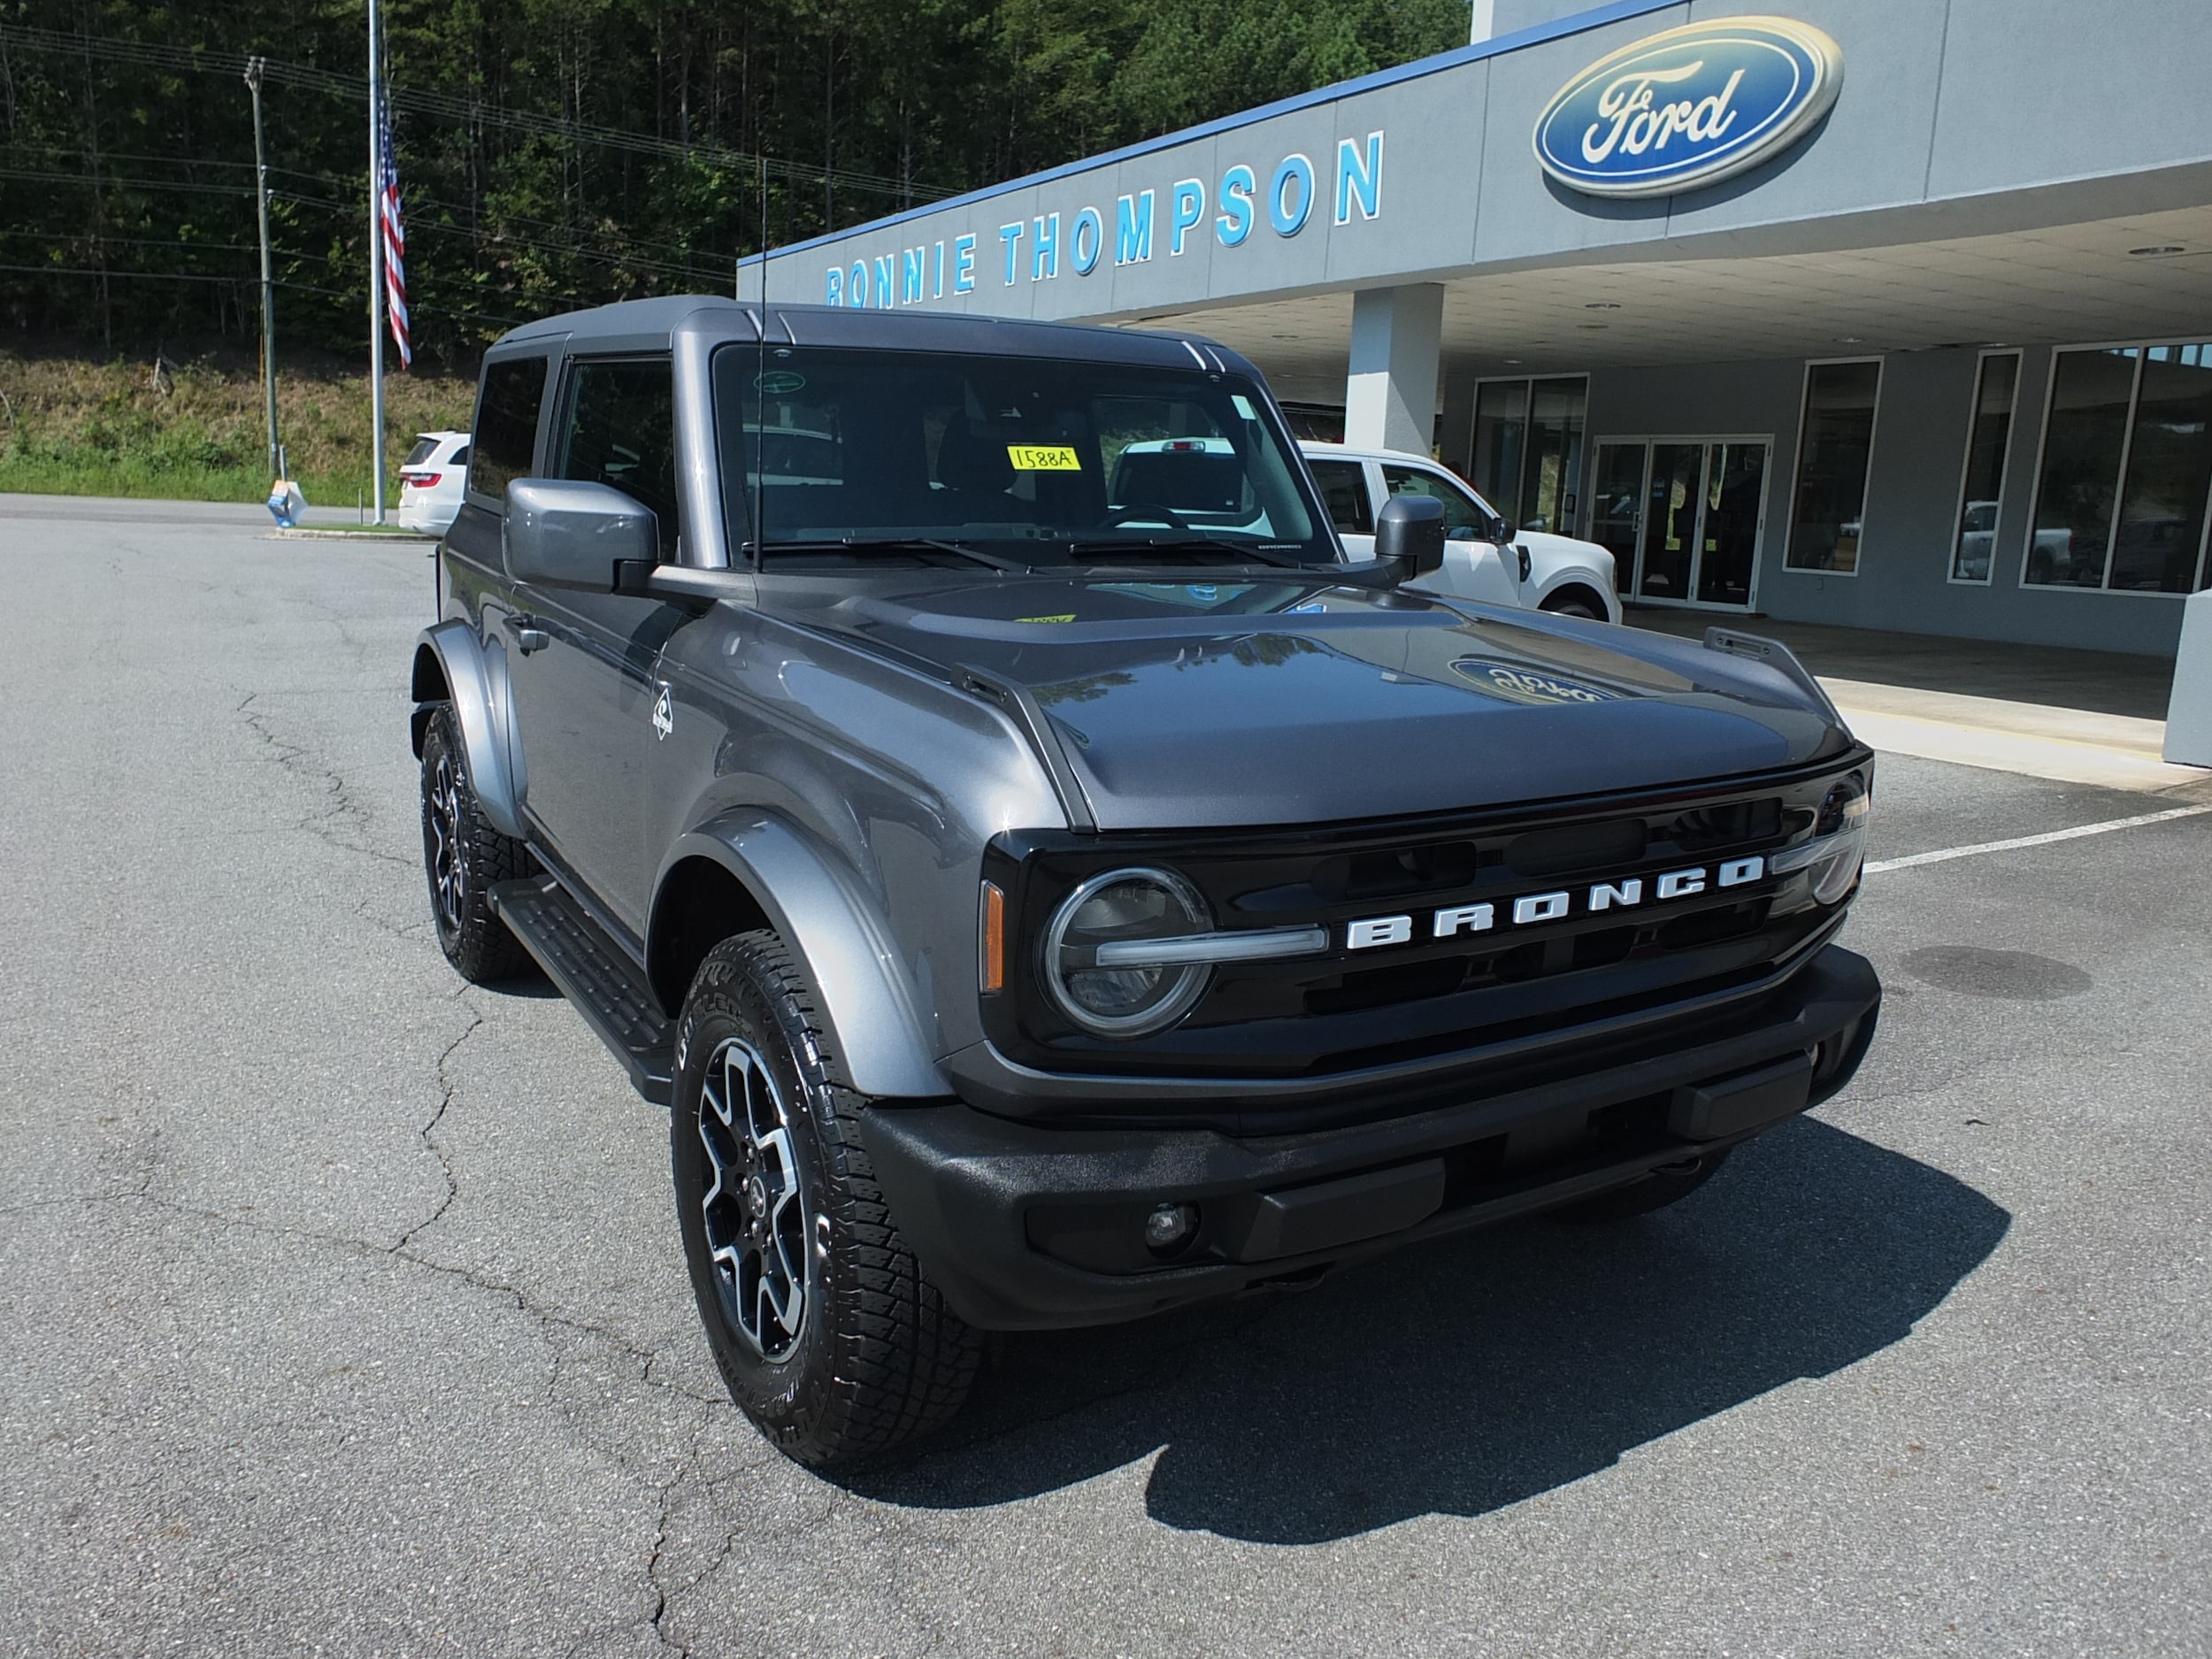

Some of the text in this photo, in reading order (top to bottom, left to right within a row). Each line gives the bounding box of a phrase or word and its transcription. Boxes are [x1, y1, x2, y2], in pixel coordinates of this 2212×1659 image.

[1581, 60, 1746, 164] Ford
[826, 130, 1385, 310] RONNIE THOMPSON
[1015, 449, 1073, 468] 1588A
[1347, 856, 1764, 949] BRONCO
